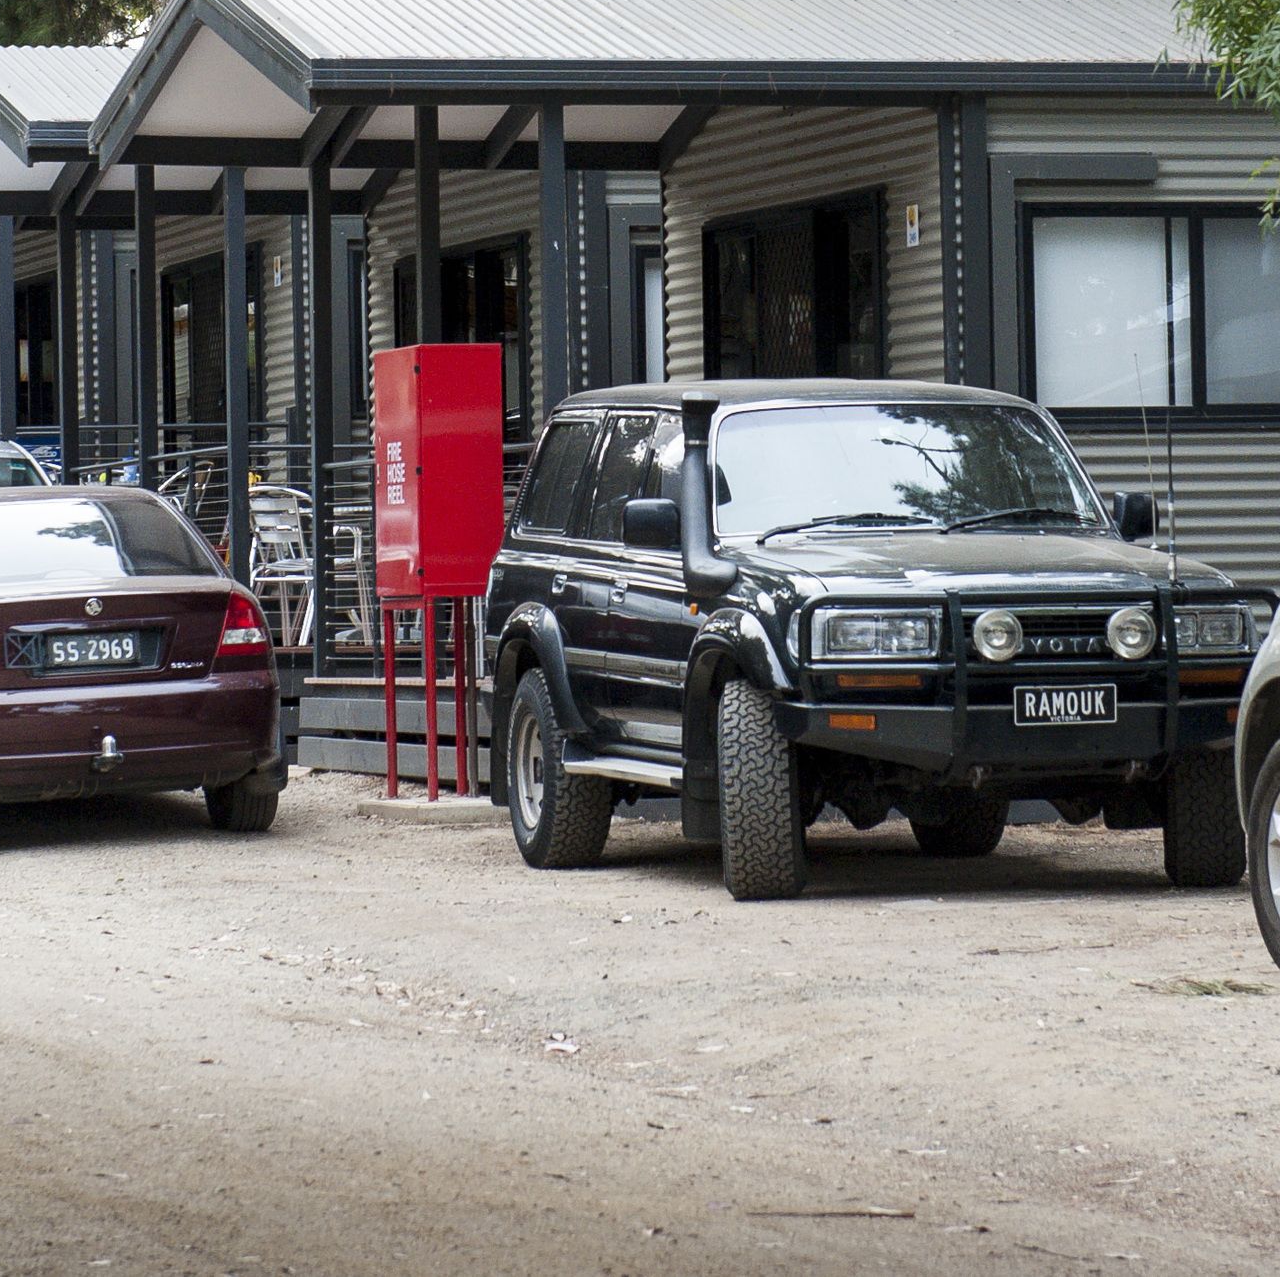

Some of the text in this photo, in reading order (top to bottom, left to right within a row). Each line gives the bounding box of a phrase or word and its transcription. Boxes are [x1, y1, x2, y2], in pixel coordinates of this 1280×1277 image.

[387, 441, 402, 462] FIRE
[387, 462, 406, 483] HOSE
[387, 484, 406, 505] REEL
[1019, 636, 1102, 653] YOTA
[1025, 690, 1106, 717] RAMOUK
